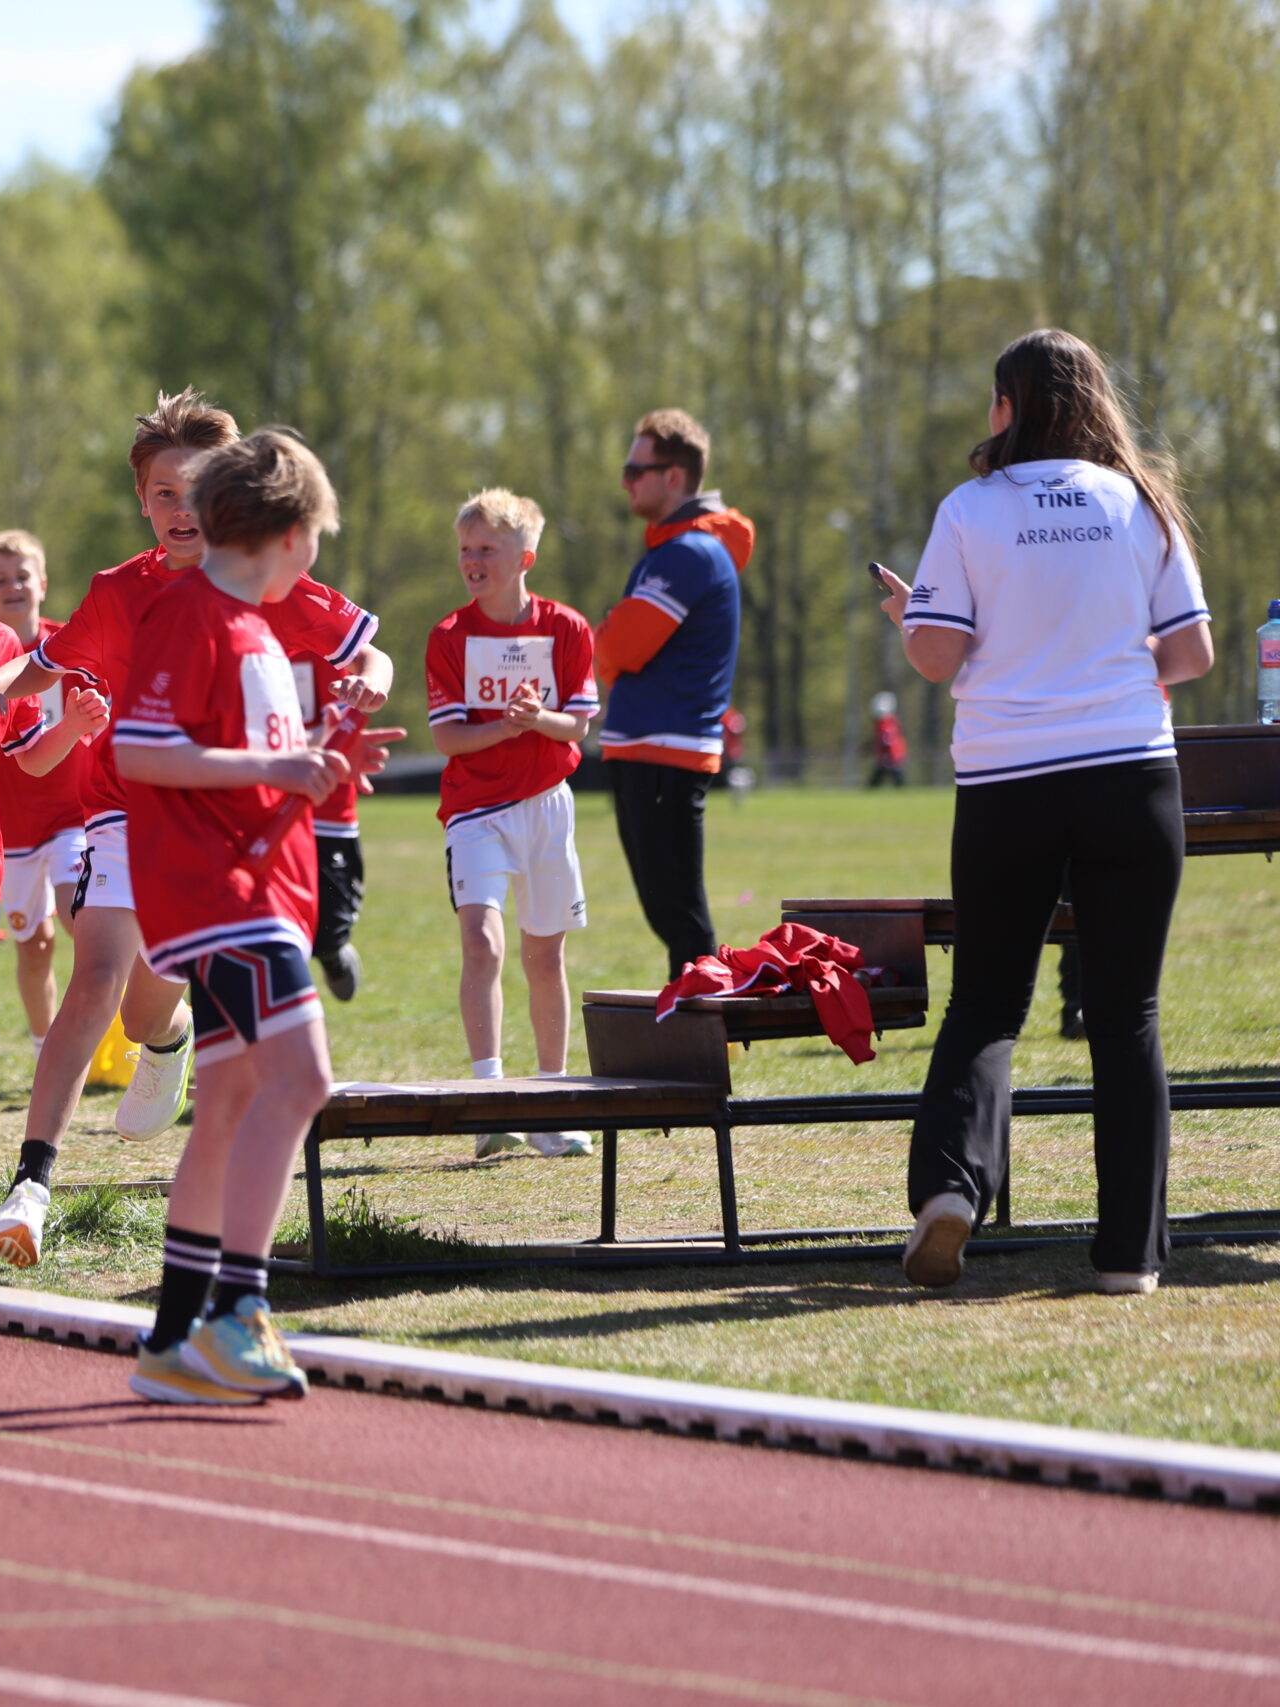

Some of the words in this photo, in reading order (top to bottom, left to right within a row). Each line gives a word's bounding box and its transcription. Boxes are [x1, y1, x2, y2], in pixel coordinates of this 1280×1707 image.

[1033, 492, 1088, 508] TINE
[1016, 526, 1113, 546] ARRANGØR
[502, 654, 527, 663] TINE
